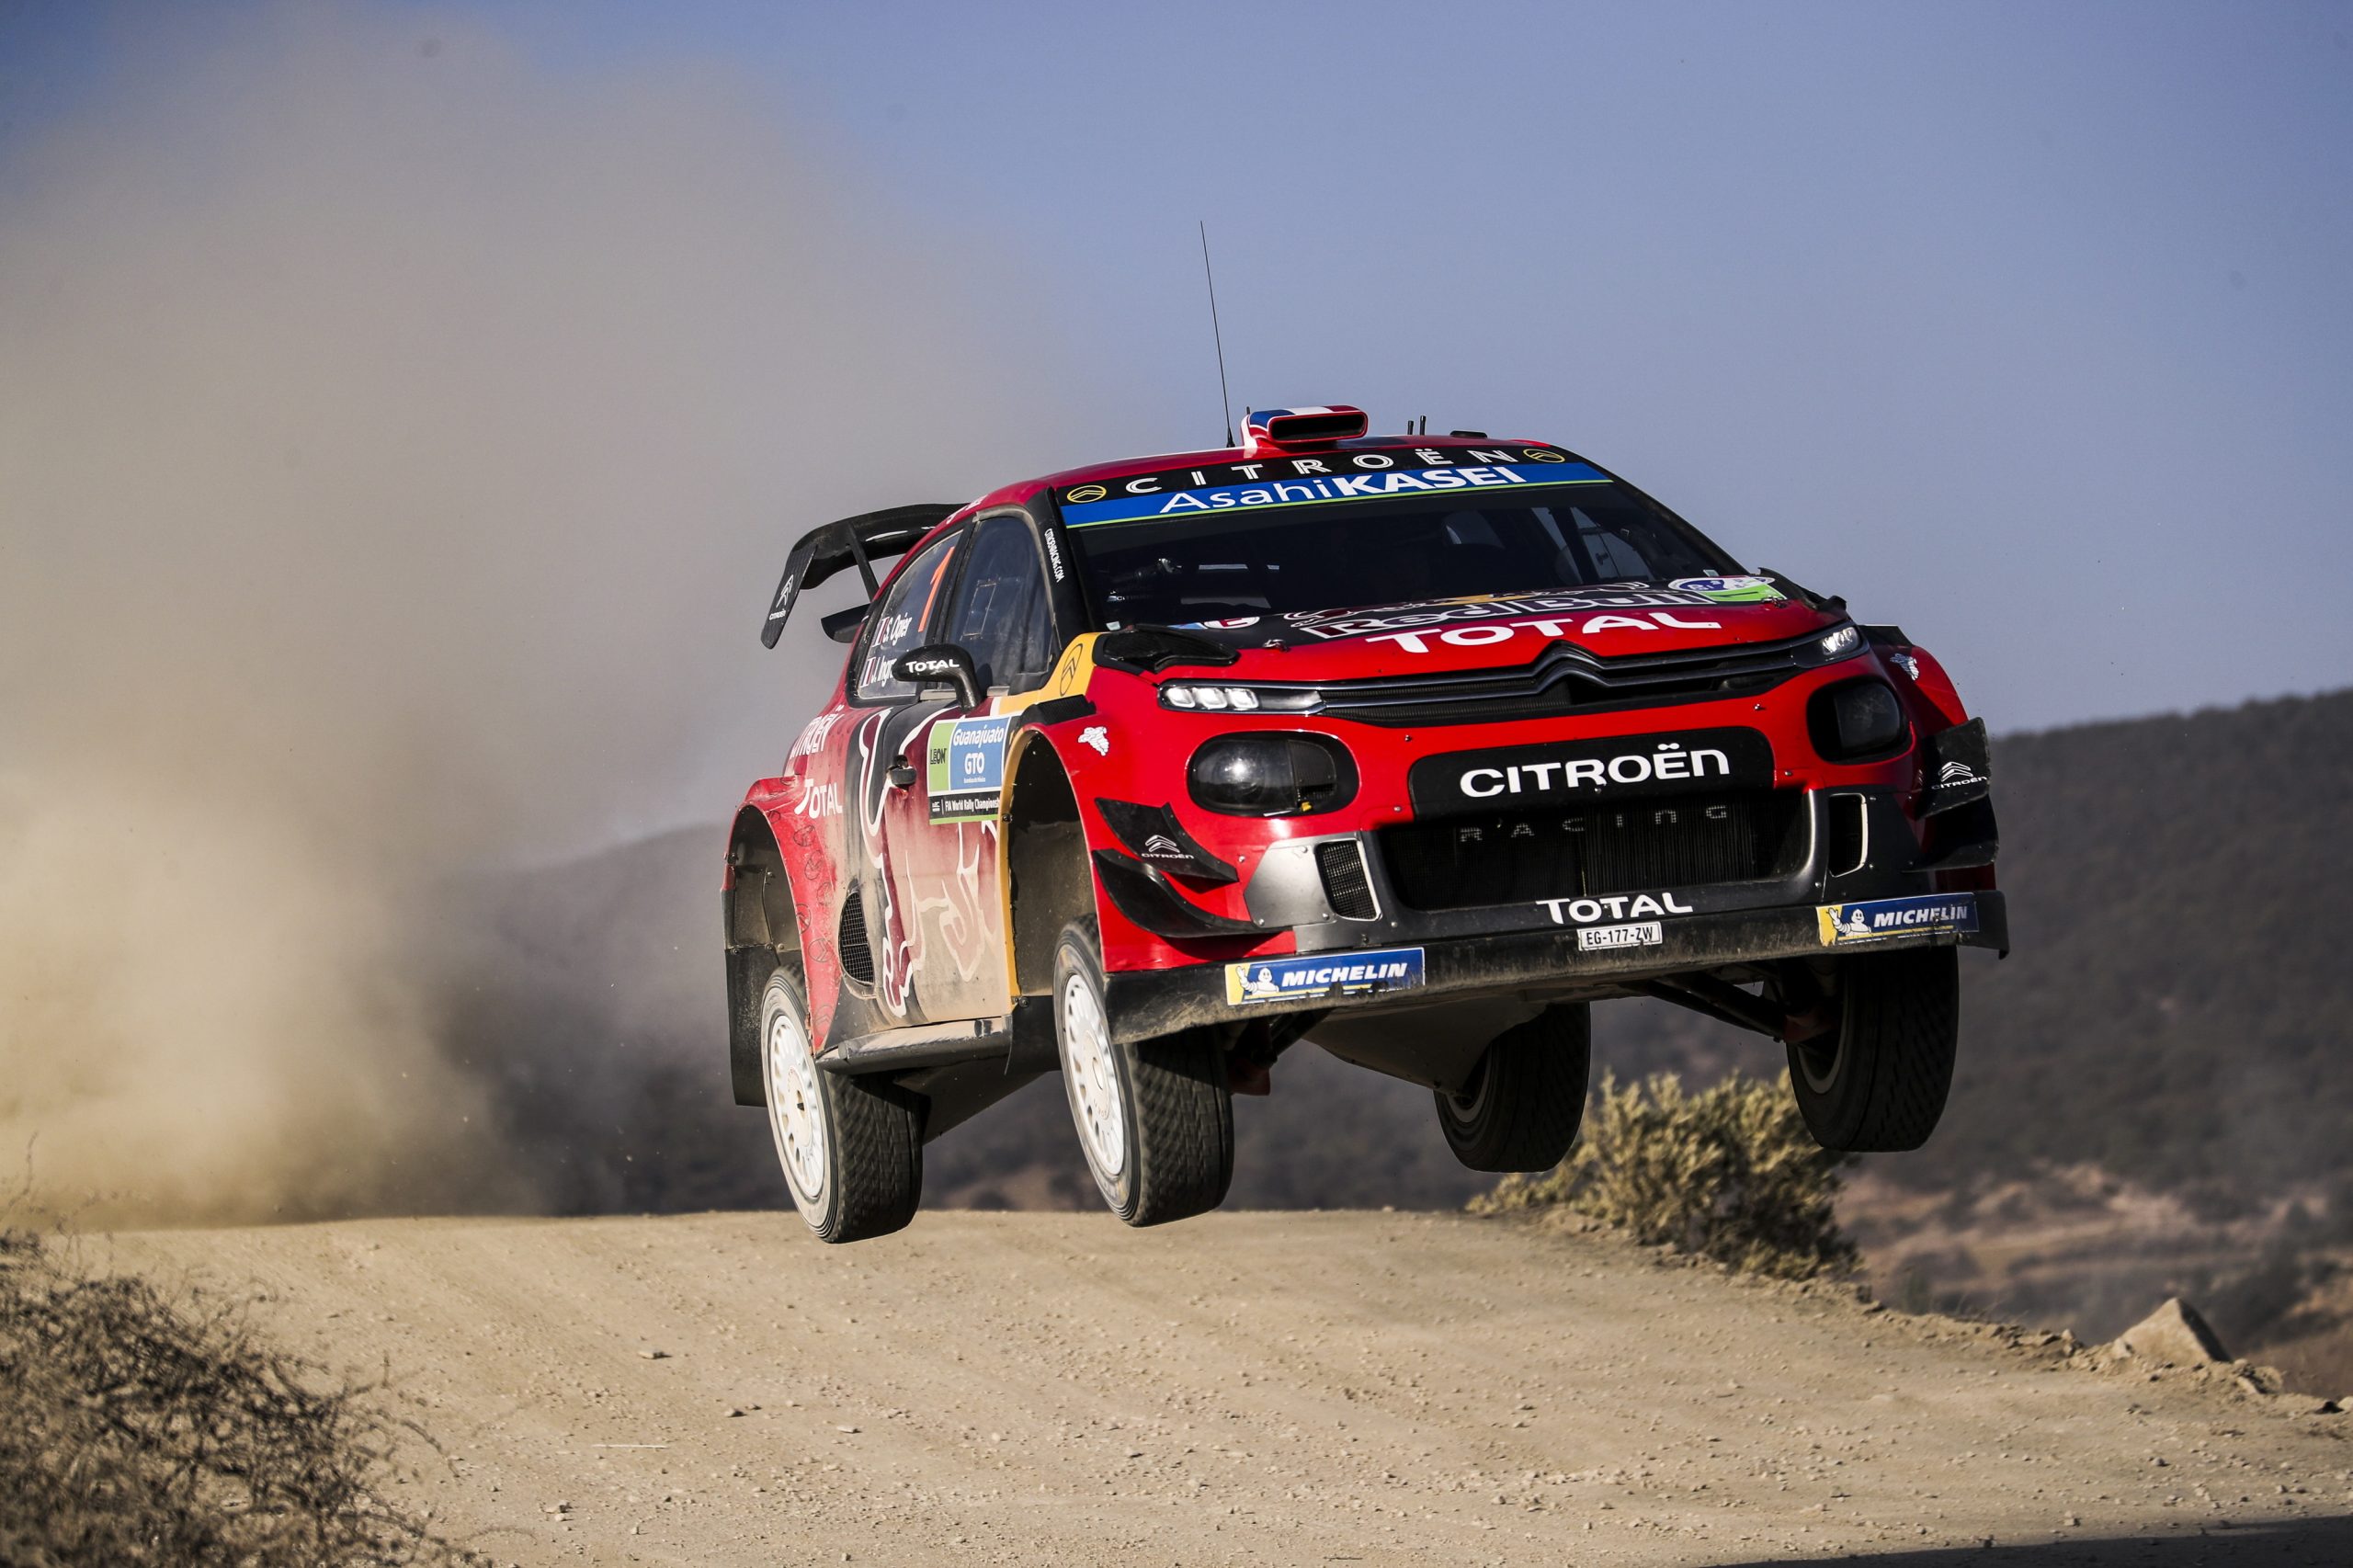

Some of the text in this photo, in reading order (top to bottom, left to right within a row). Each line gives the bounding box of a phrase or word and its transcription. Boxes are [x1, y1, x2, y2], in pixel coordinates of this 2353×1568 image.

[1125, 448, 1519, 494] CITROËN
[890, 612, 913, 646] Ogier
[1300, 593, 1718, 640] Red Bull
[1366, 612, 1722, 653] TOTAL
[905, 659, 960, 674] TOTAL
[952, 724, 1005, 748] Guanajuato
[964, 752, 985, 775] GTO
[1460, 742, 1730, 798] CITROËN
[794, 778, 843, 819] TOTAL
[951, 799, 964, 811] World
[963, 799, 975, 812] Rally
[1460, 805, 1728, 843] RACING
[1536, 892, 1694, 925] TOTAL
[1873, 904, 1968, 928] MICHELIN
[1586, 926, 1654, 946] EG-177-ZW
[1282, 962, 1408, 987] MICHELIN
